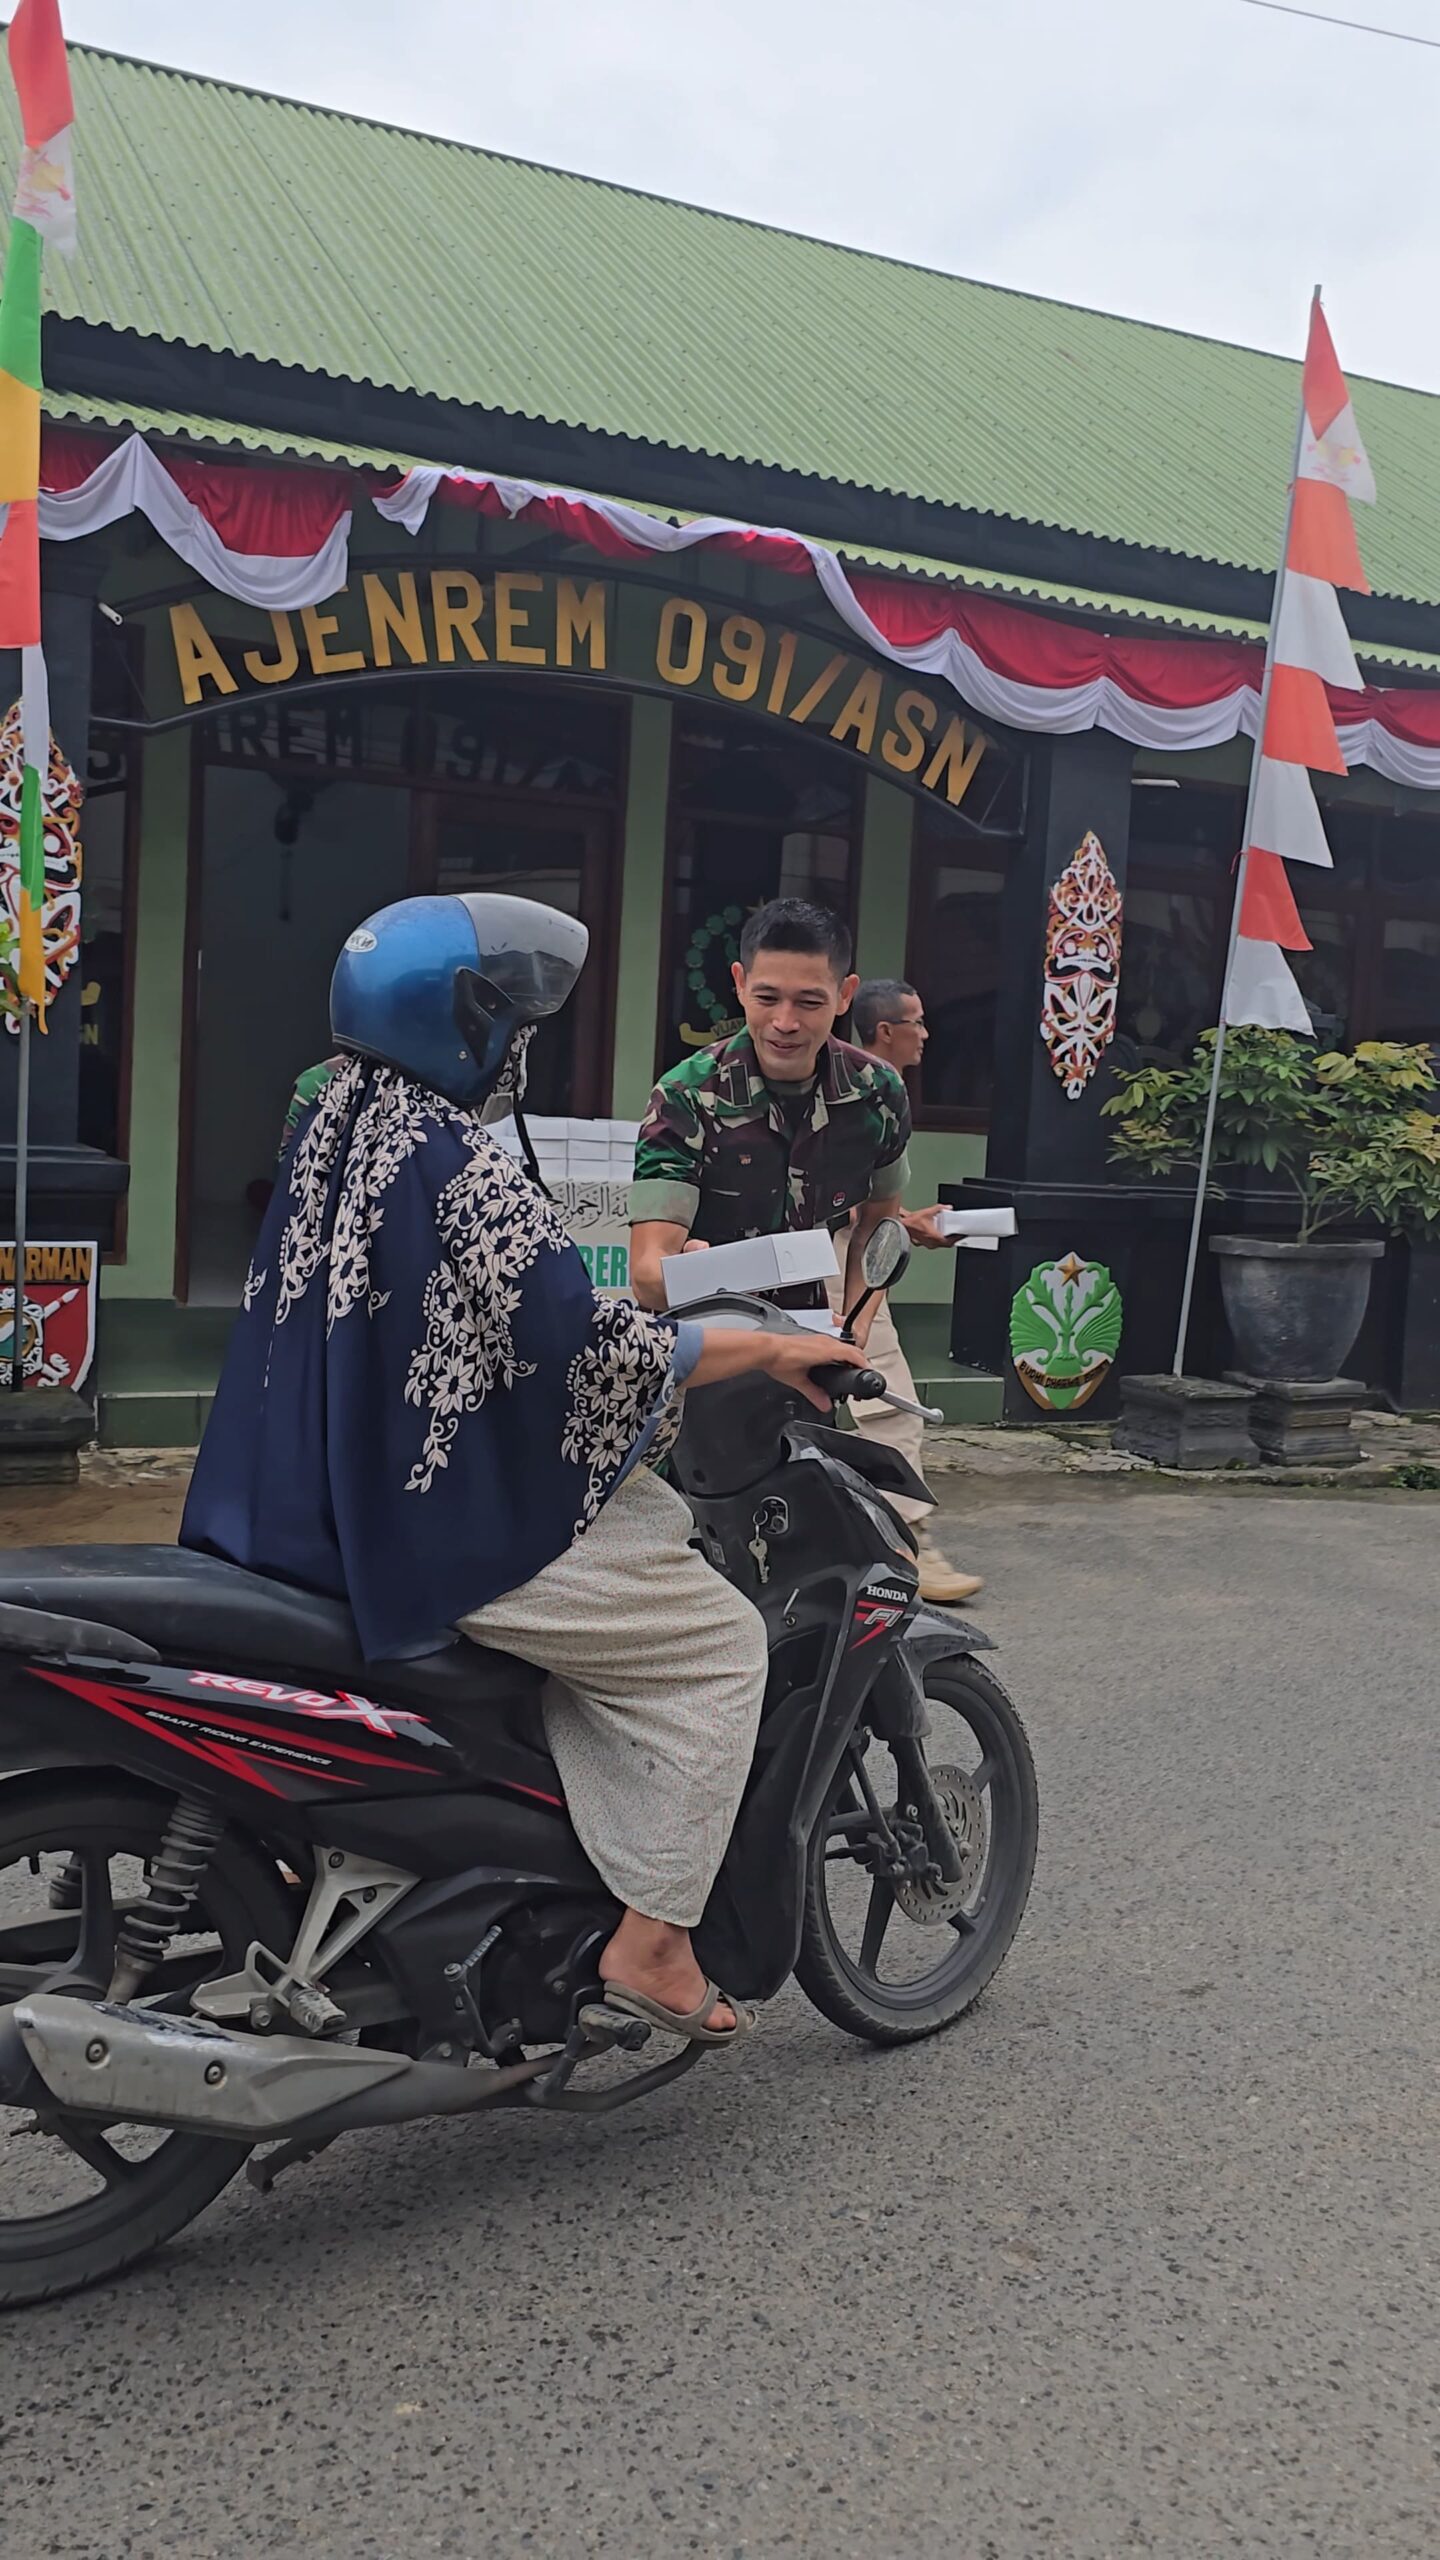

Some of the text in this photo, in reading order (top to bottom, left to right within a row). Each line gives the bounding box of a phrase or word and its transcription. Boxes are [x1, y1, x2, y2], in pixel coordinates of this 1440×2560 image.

[656, 597, 988, 806] 091/ASN
[578, 1246, 632, 1287] BER
[866, 1585, 909, 1603] HONDA
[864, 1608, 904, 1627] FI
[145, 1710, 333, 1766] SMART RIDING EXPERIENCE
